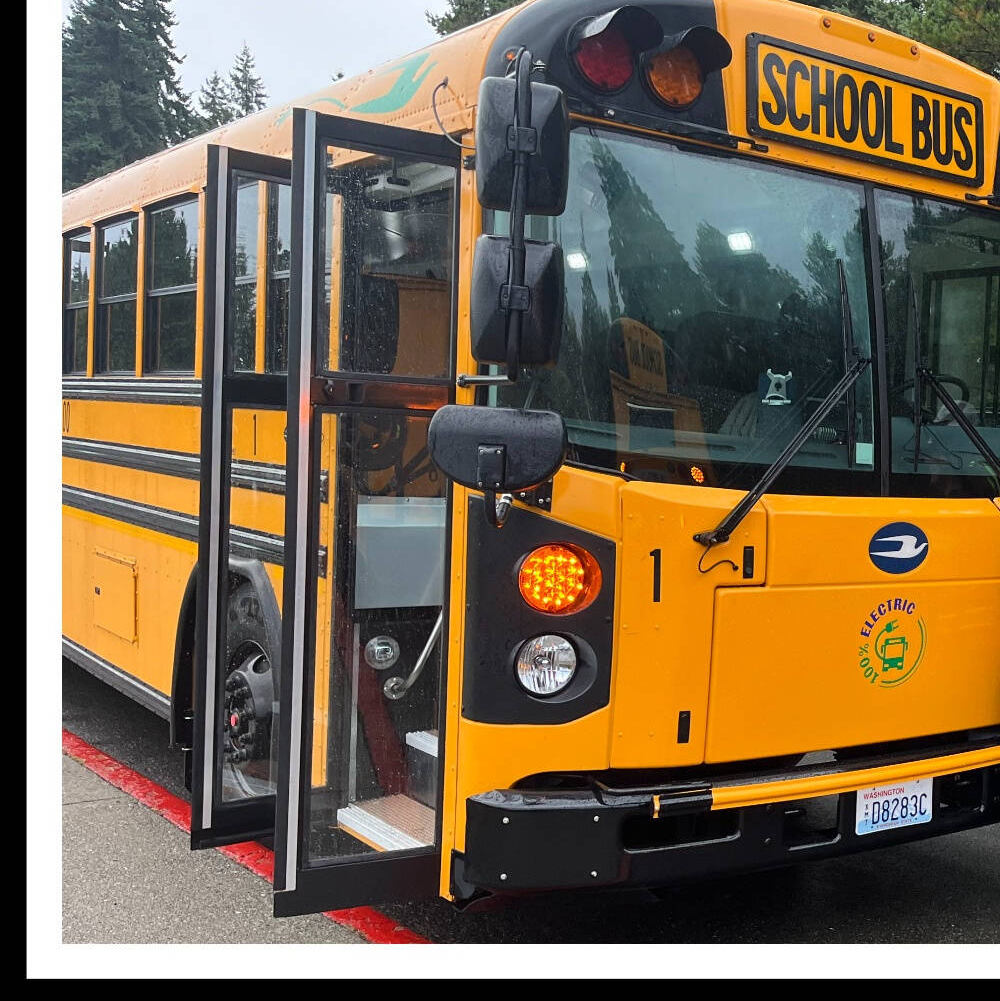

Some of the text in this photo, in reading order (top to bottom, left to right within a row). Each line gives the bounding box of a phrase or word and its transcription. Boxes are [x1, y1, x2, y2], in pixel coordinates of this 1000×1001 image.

[761, 52, 974, 171] SCHOOL BUS
[649, 549, 662, 602] 1
[858, 598, 916, 684] 100% ELECTRIC
[863, 786, 905, 800] WASHINGTON
[872, 793, 928, 825] D8283C
